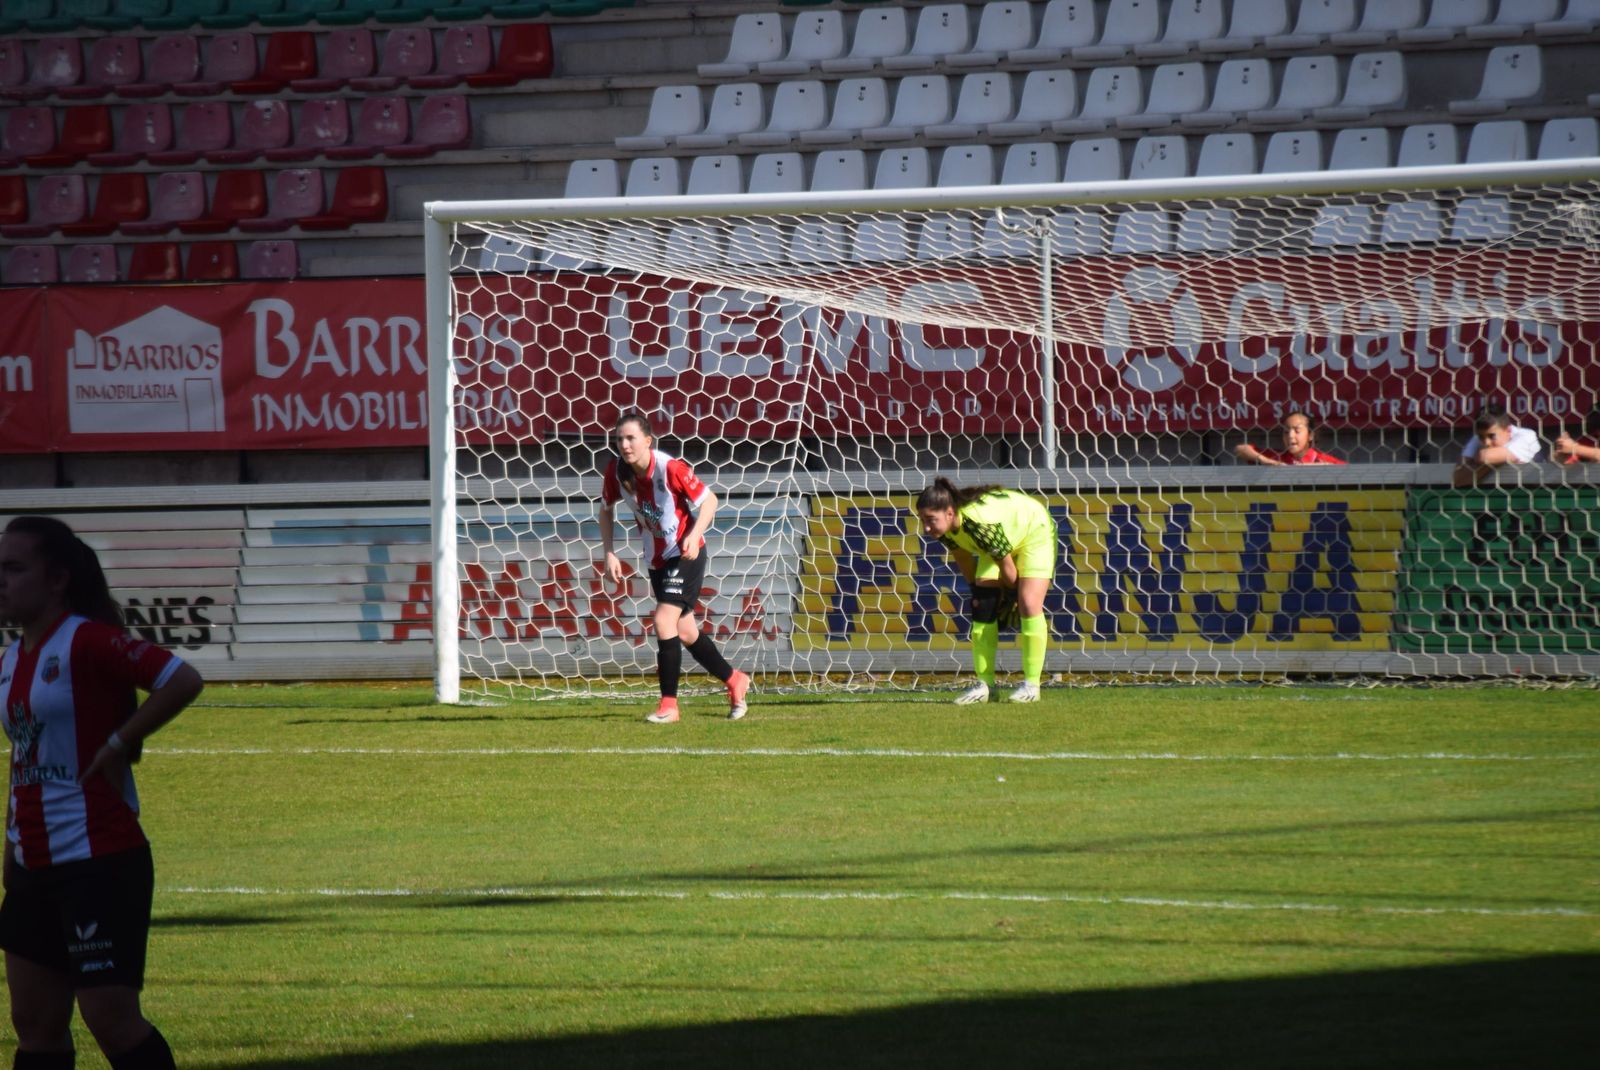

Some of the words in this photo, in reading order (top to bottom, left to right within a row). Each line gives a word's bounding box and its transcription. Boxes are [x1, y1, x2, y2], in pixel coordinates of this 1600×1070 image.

[246, 297, 524, 379] BARROS
[608, 280, 987, 377] UEMC
[1224, 270, 1566, 374] Cualtis
[99, 336, 219, 371] BARRIOS
[75, 384, 177, 400] INMOBILIARIA
[252, 389, 524, 432] INMOBILIRIA
[1373, 395, 1568, 418] TRANQUIDAD
